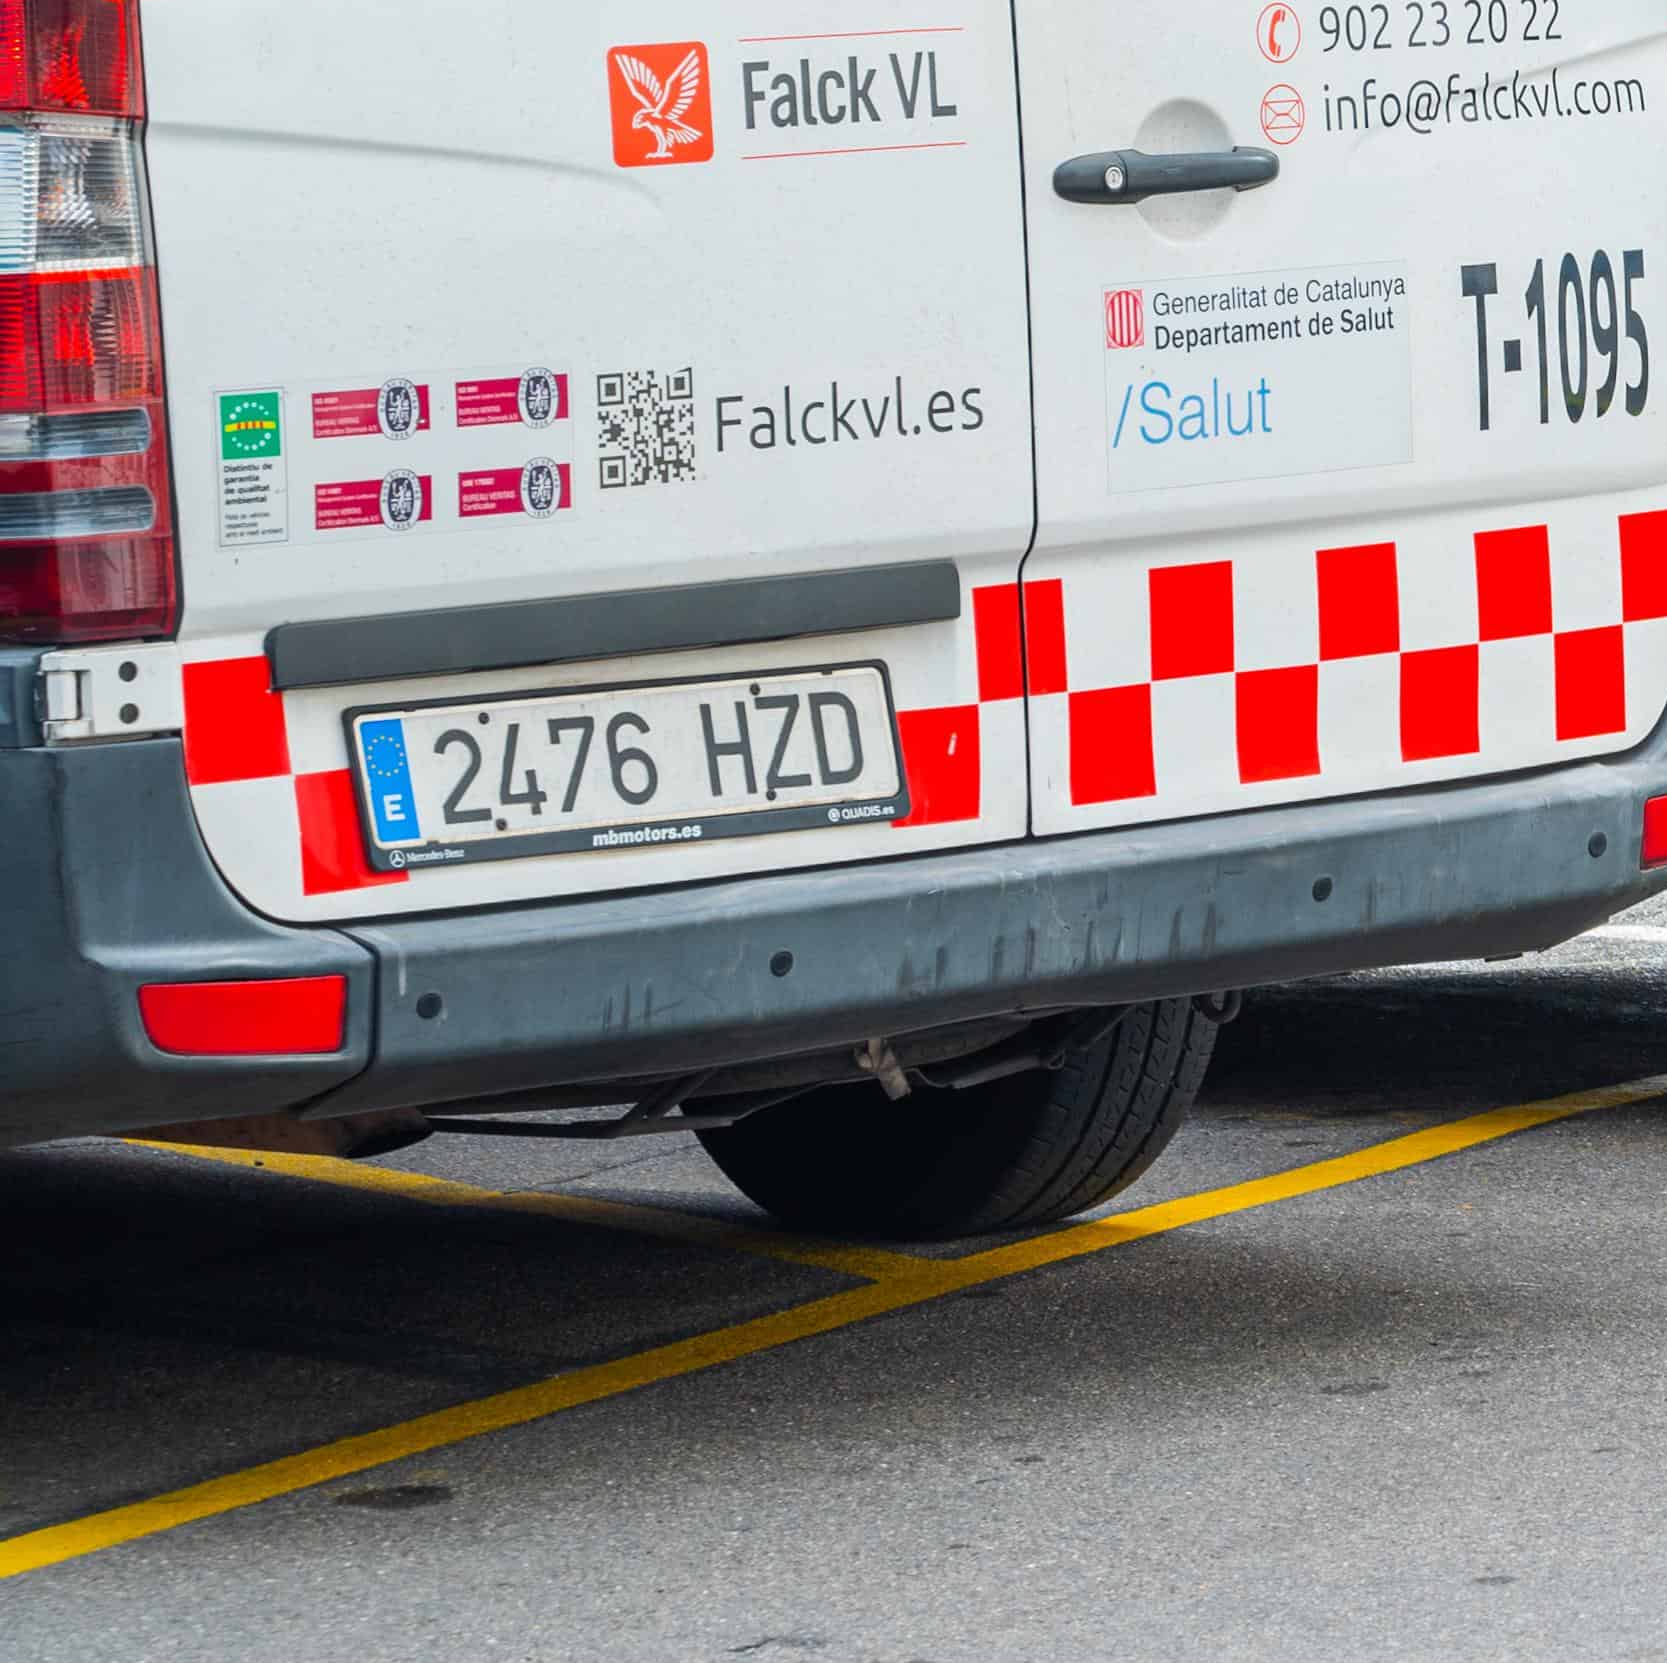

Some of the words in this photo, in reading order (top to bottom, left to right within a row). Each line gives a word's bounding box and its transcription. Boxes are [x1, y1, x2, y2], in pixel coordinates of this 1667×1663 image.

[1319, 3, 1392, 52] 902
[1405, 0, 1450, 48] 23
[741, 56, 881, 129] Falck
[889, 51, 957, 120] VL
[1322, 67, 1647, 135] info@falckvl.com
[1153, 289, 1267, 317] Generalitat
[1273, 285, 1299, 308] de
[1305, 276, 1406, 306] Catalunya
[1154, 318, 1301, 354] Departament
[1307, 314, 1335, 336] de
[1340, 309, 1395, 334] Salut
[1461, 249, 1649, 431] T-1095
[715, 375, 984, 453] Falckvl.es
[434, 711, 658, 825] 2476
[699, 691, 866, 798] HZD
[383, 793, 406, 822] E
[593, 824, 702, 848] mbmotors.es
